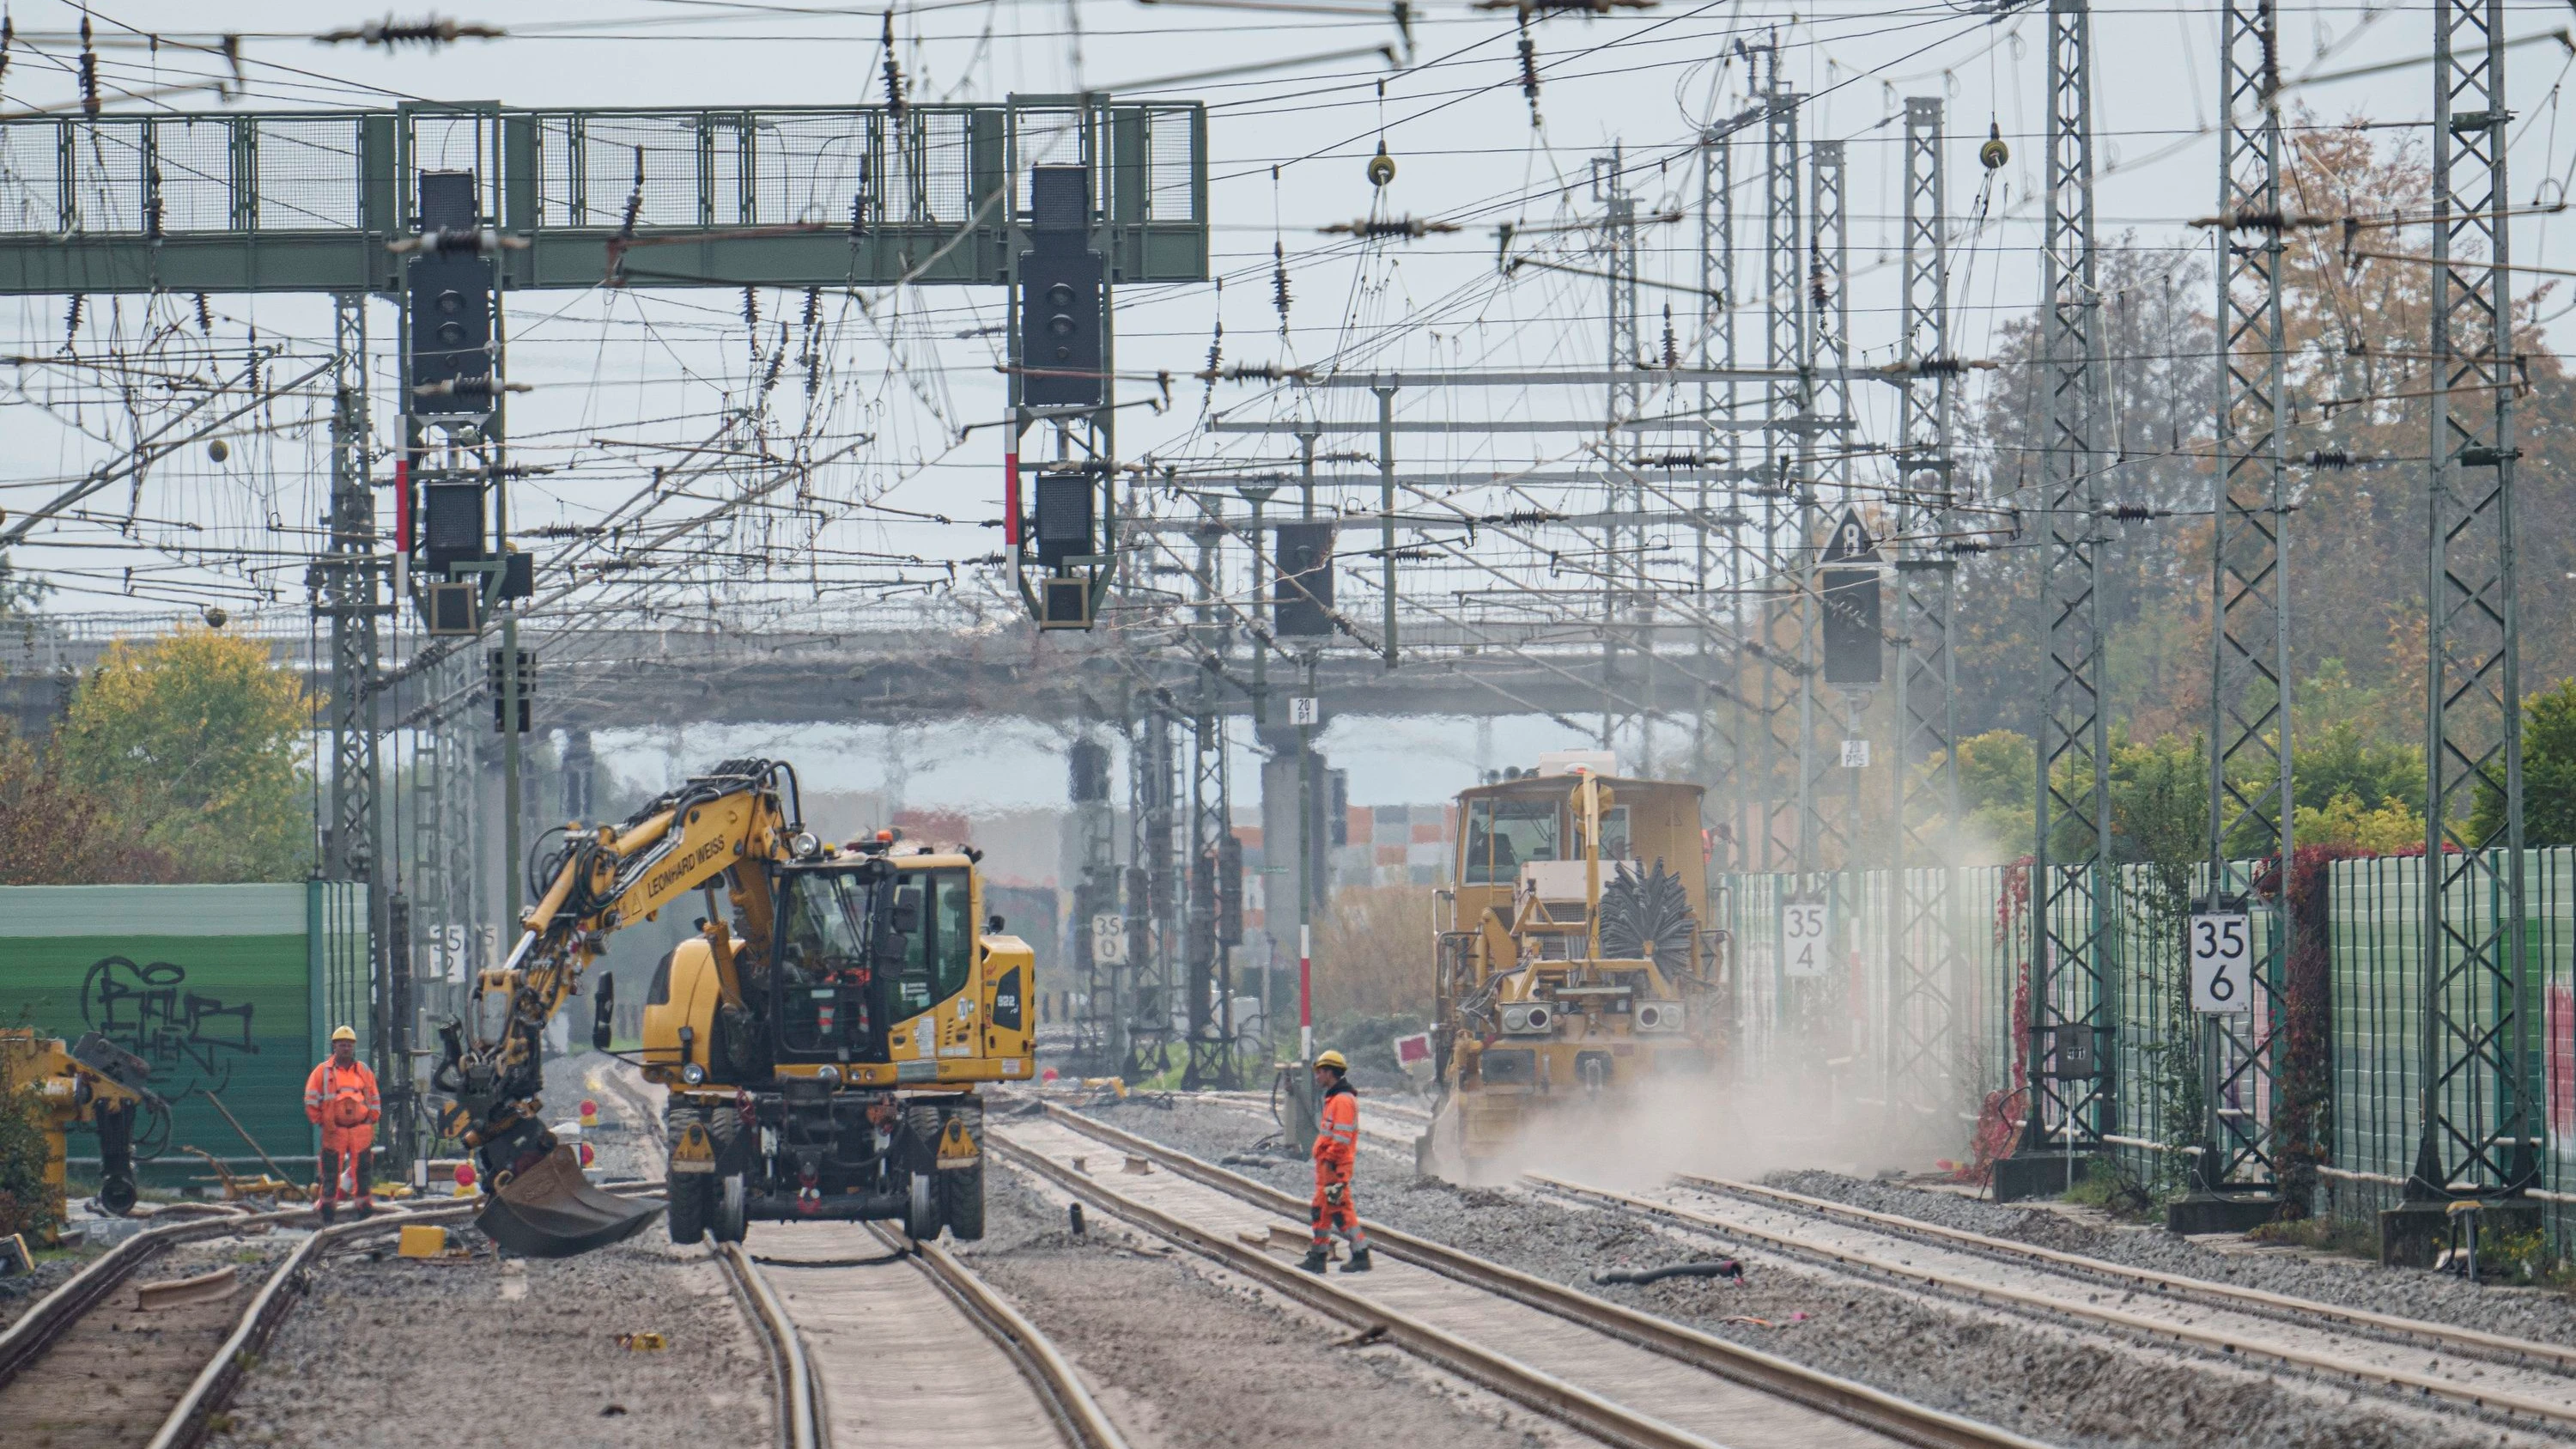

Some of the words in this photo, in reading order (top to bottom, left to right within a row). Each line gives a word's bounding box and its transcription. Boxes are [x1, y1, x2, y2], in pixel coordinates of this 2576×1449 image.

[1297, 698, 1310, 711] 20
[647, 854, 696, 898] LEONHARD
[696, 834, 726, 864] WEISS
[1094, 916, 1120, 936] 35
[1788, 909, 1822, 938] 35
[2196, 921, 2244, 959] 35
[1795, 942, 1814, 969] 4
[2209, 964, 2234, 1002] 6
[997, 995, 1016, 1008] 922
